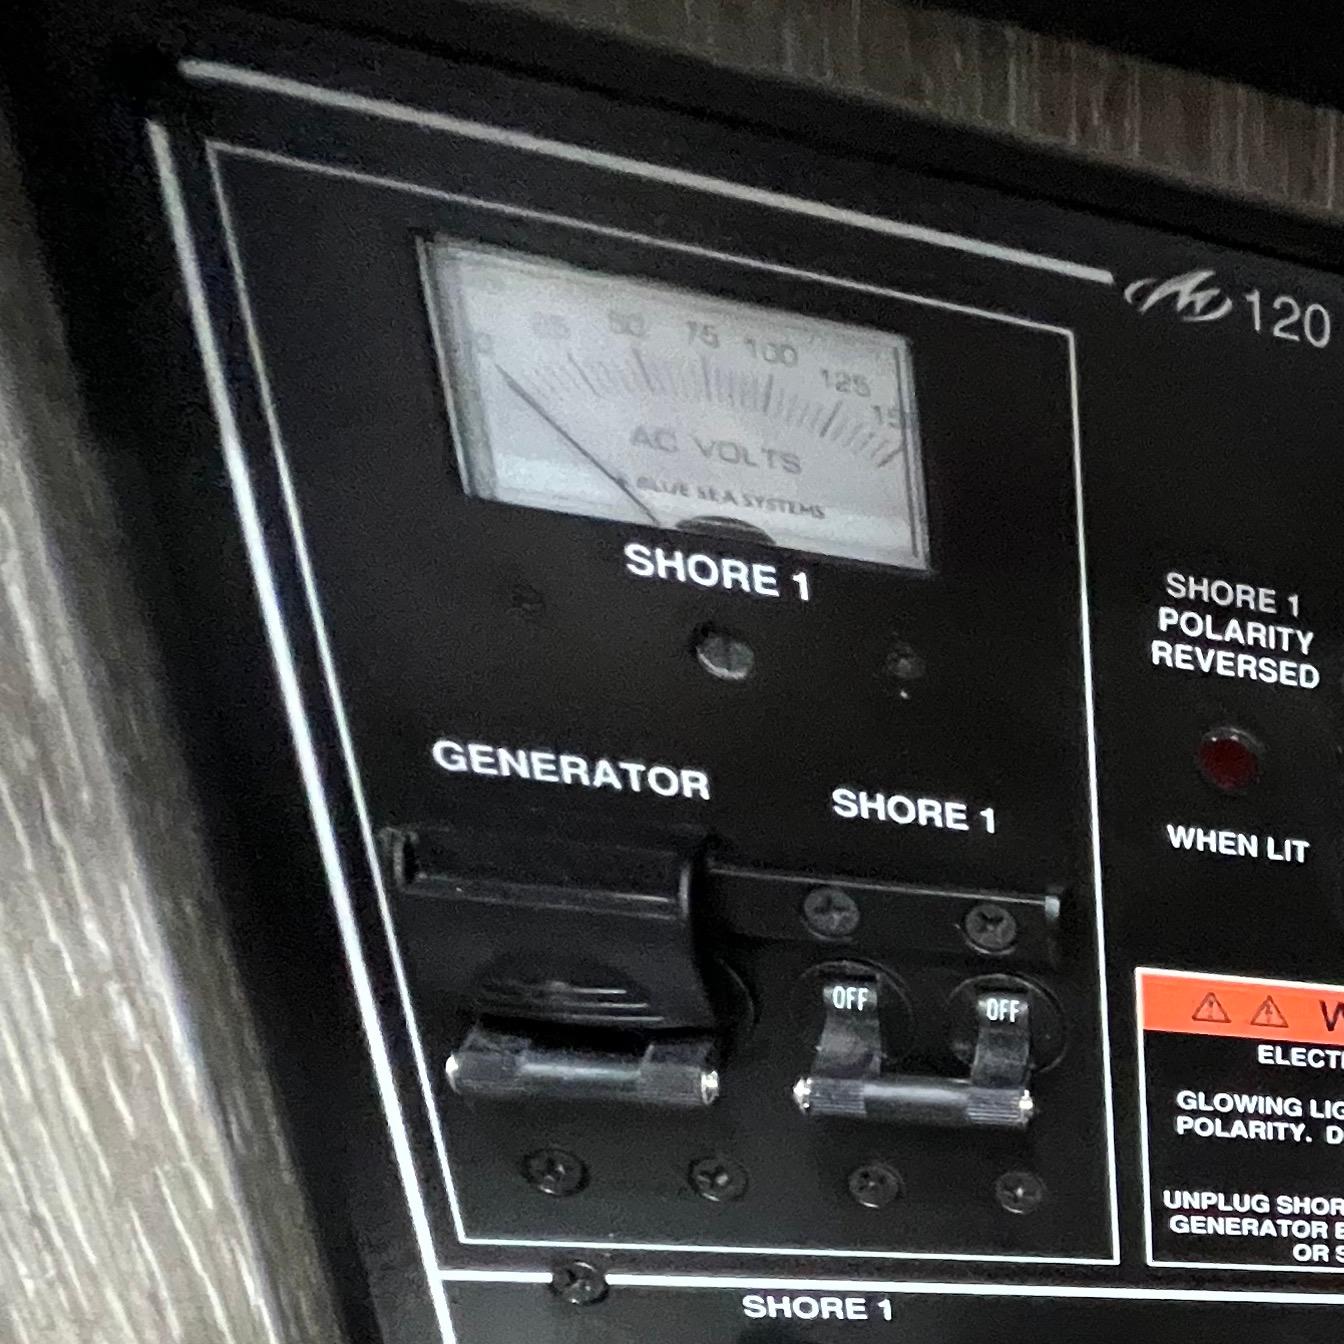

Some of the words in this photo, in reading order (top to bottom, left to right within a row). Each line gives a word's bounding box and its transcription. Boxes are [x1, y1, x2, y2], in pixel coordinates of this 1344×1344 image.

[1246, 289, 1331, 348] 120
[687, 321, 718, 348] 75
[744, 338, 797, 367] 100
[822, 369, 870, 397] 125
[873, 405, 903, 428] 15
[629, 425, 678, 451] AC
[690, 434, 801, 474] VOLTS
[624, 543, 779, 597] SHORE
[793, 572, 811, 600] 1
[1166, 571, 1277, 615] SHORE
[1288, 593, 1299, 618] 1
[1158, 607, 1315, 655] POLARITY
[1151, 640, 1320, 690] REVERSED
[432, 738, 710, 800] GENERATOR
[833, 788, 968, 831] SHORE
[980, 806, 996, 833] 1
[1167, 823, 1260, 858] WHEN
[1267, 834, 1309, 863] LIT
[833, 986, 869, 1010] OFF
[986, 998, 1020, 1023] OFF
[1176, 1091, 1302, 1118] GLOWING
[1177, 1116, 1312, 1144] POLARITY.
[1163, 1190, 1269, 1215] UNPLUG
[1169, 1215, 1328, 1240] GENERATOR
[1293, 1243, 1329, 1263] OR
[742, 1295, 868, 1321] SHORE
[877, 1298, 893, 1321] 1
